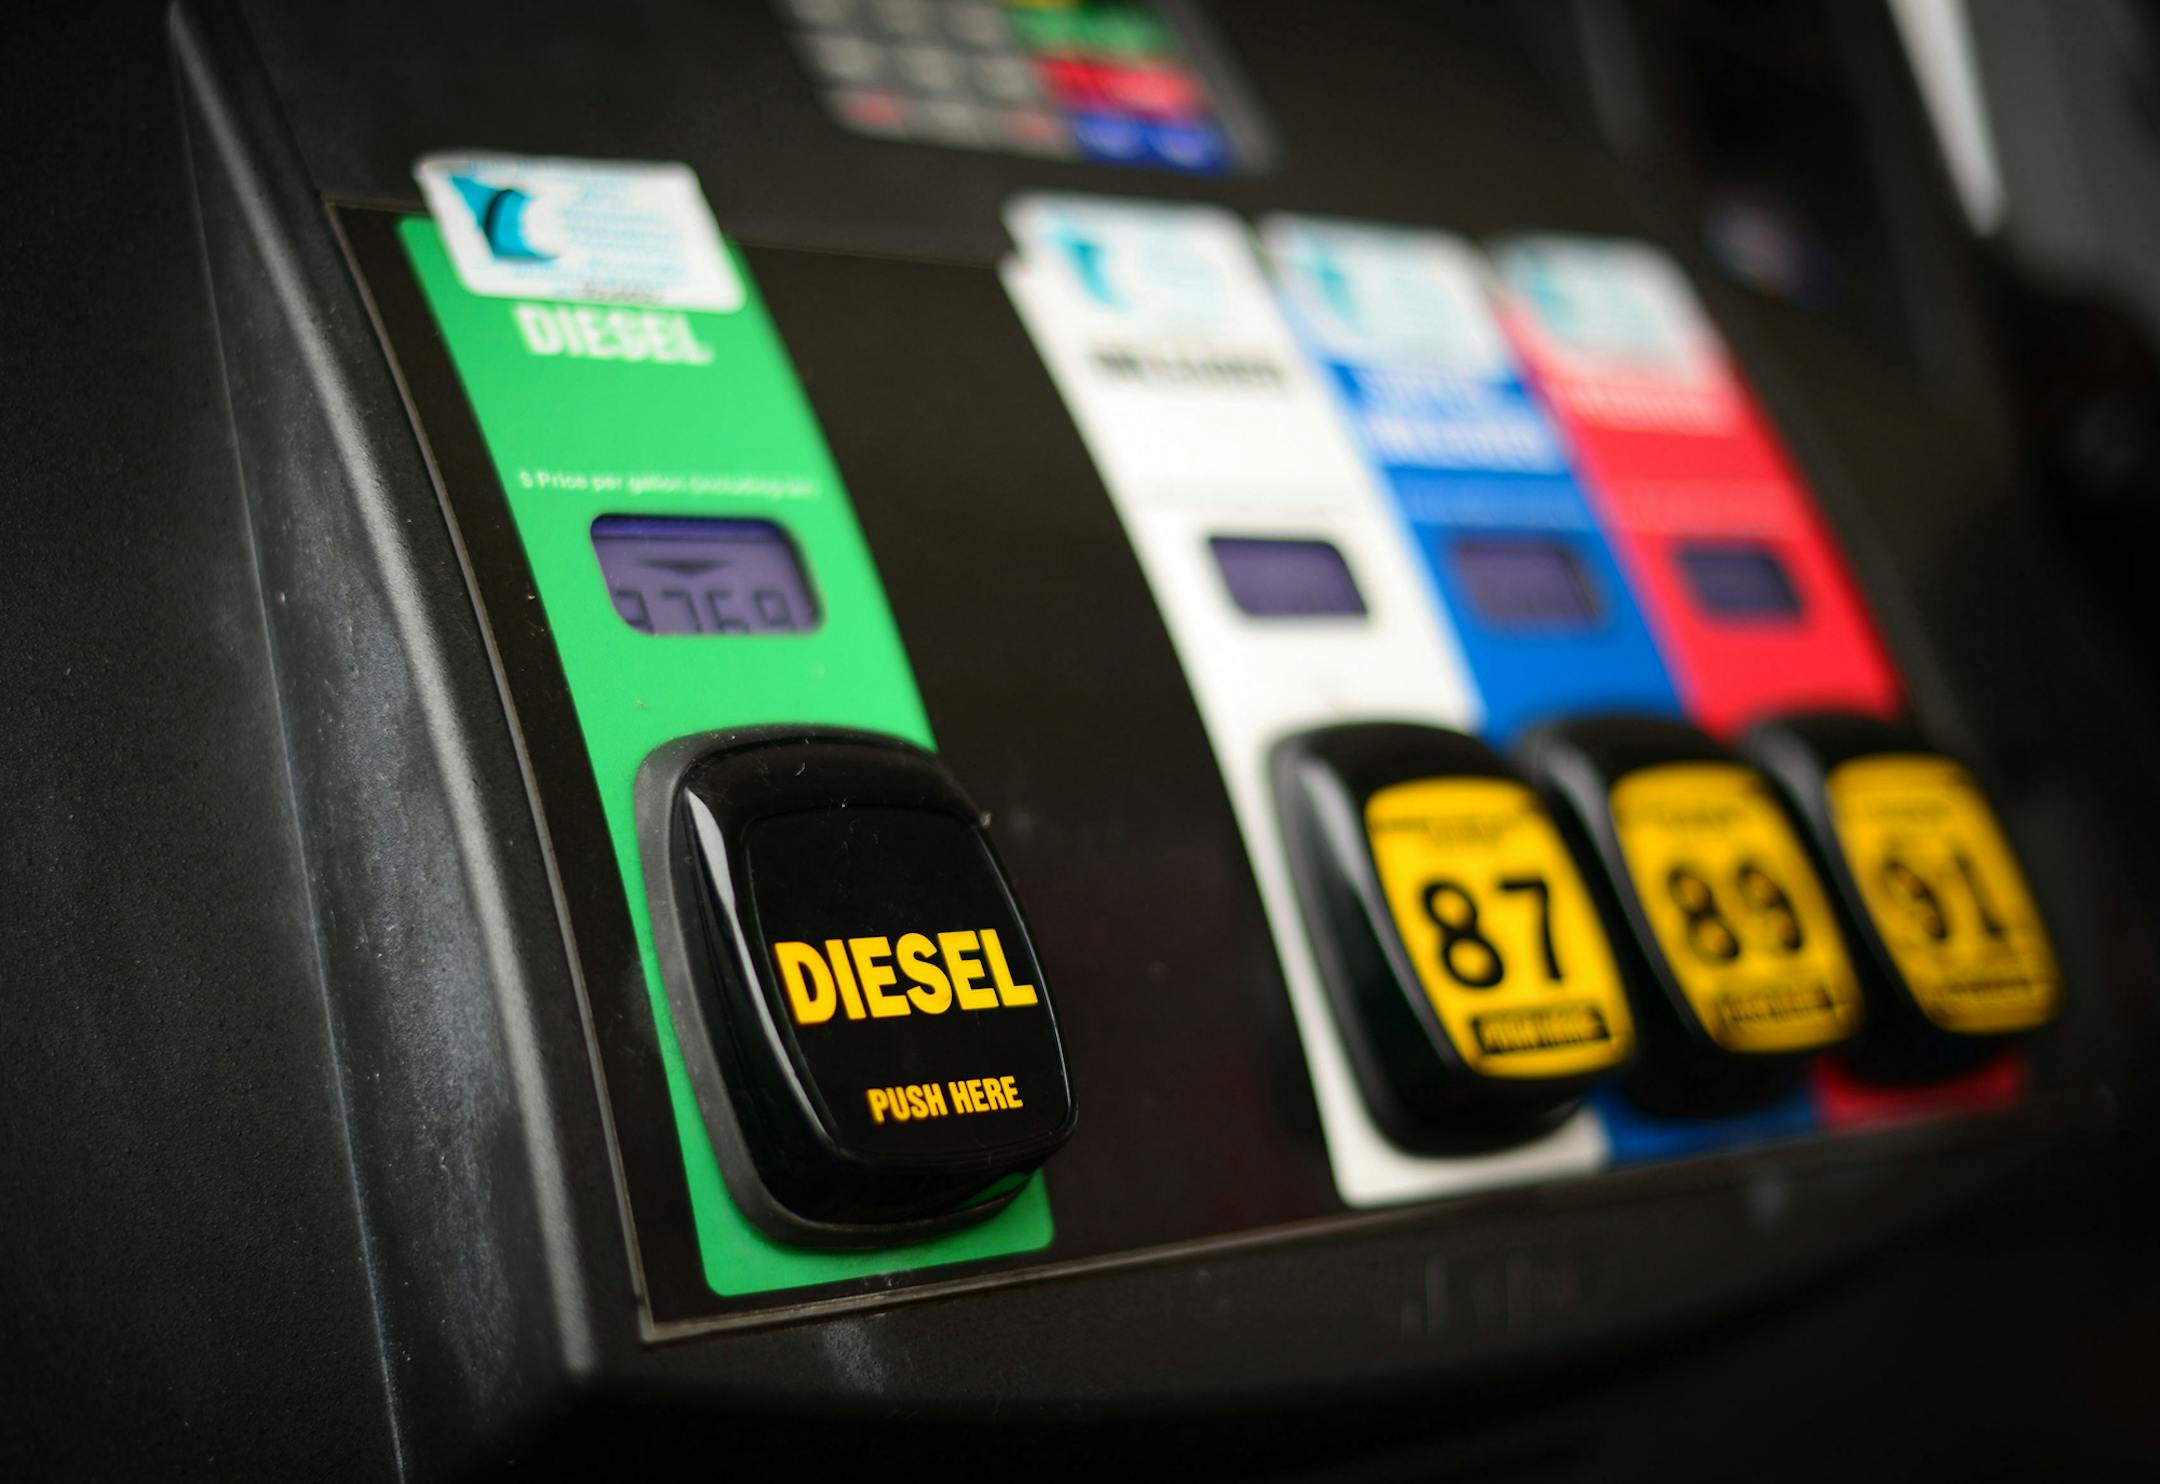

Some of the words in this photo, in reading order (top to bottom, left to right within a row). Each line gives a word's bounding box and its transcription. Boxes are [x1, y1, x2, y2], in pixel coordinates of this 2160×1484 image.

[515, 304, 716, 365] DIESEL
[537, 470, 588, 491] Price
[592, 472, 622, 493] per
[1420, 873, 1564, 989] 87
[1665, 862, 1803, 965] 89
[1880, 855, 2006, 944] 91
[773, 928, 1038, 1025] DIESEL
[866, 1083, 948, 1122] PUSH
[948, 1075, 1023, 1115] HERE
